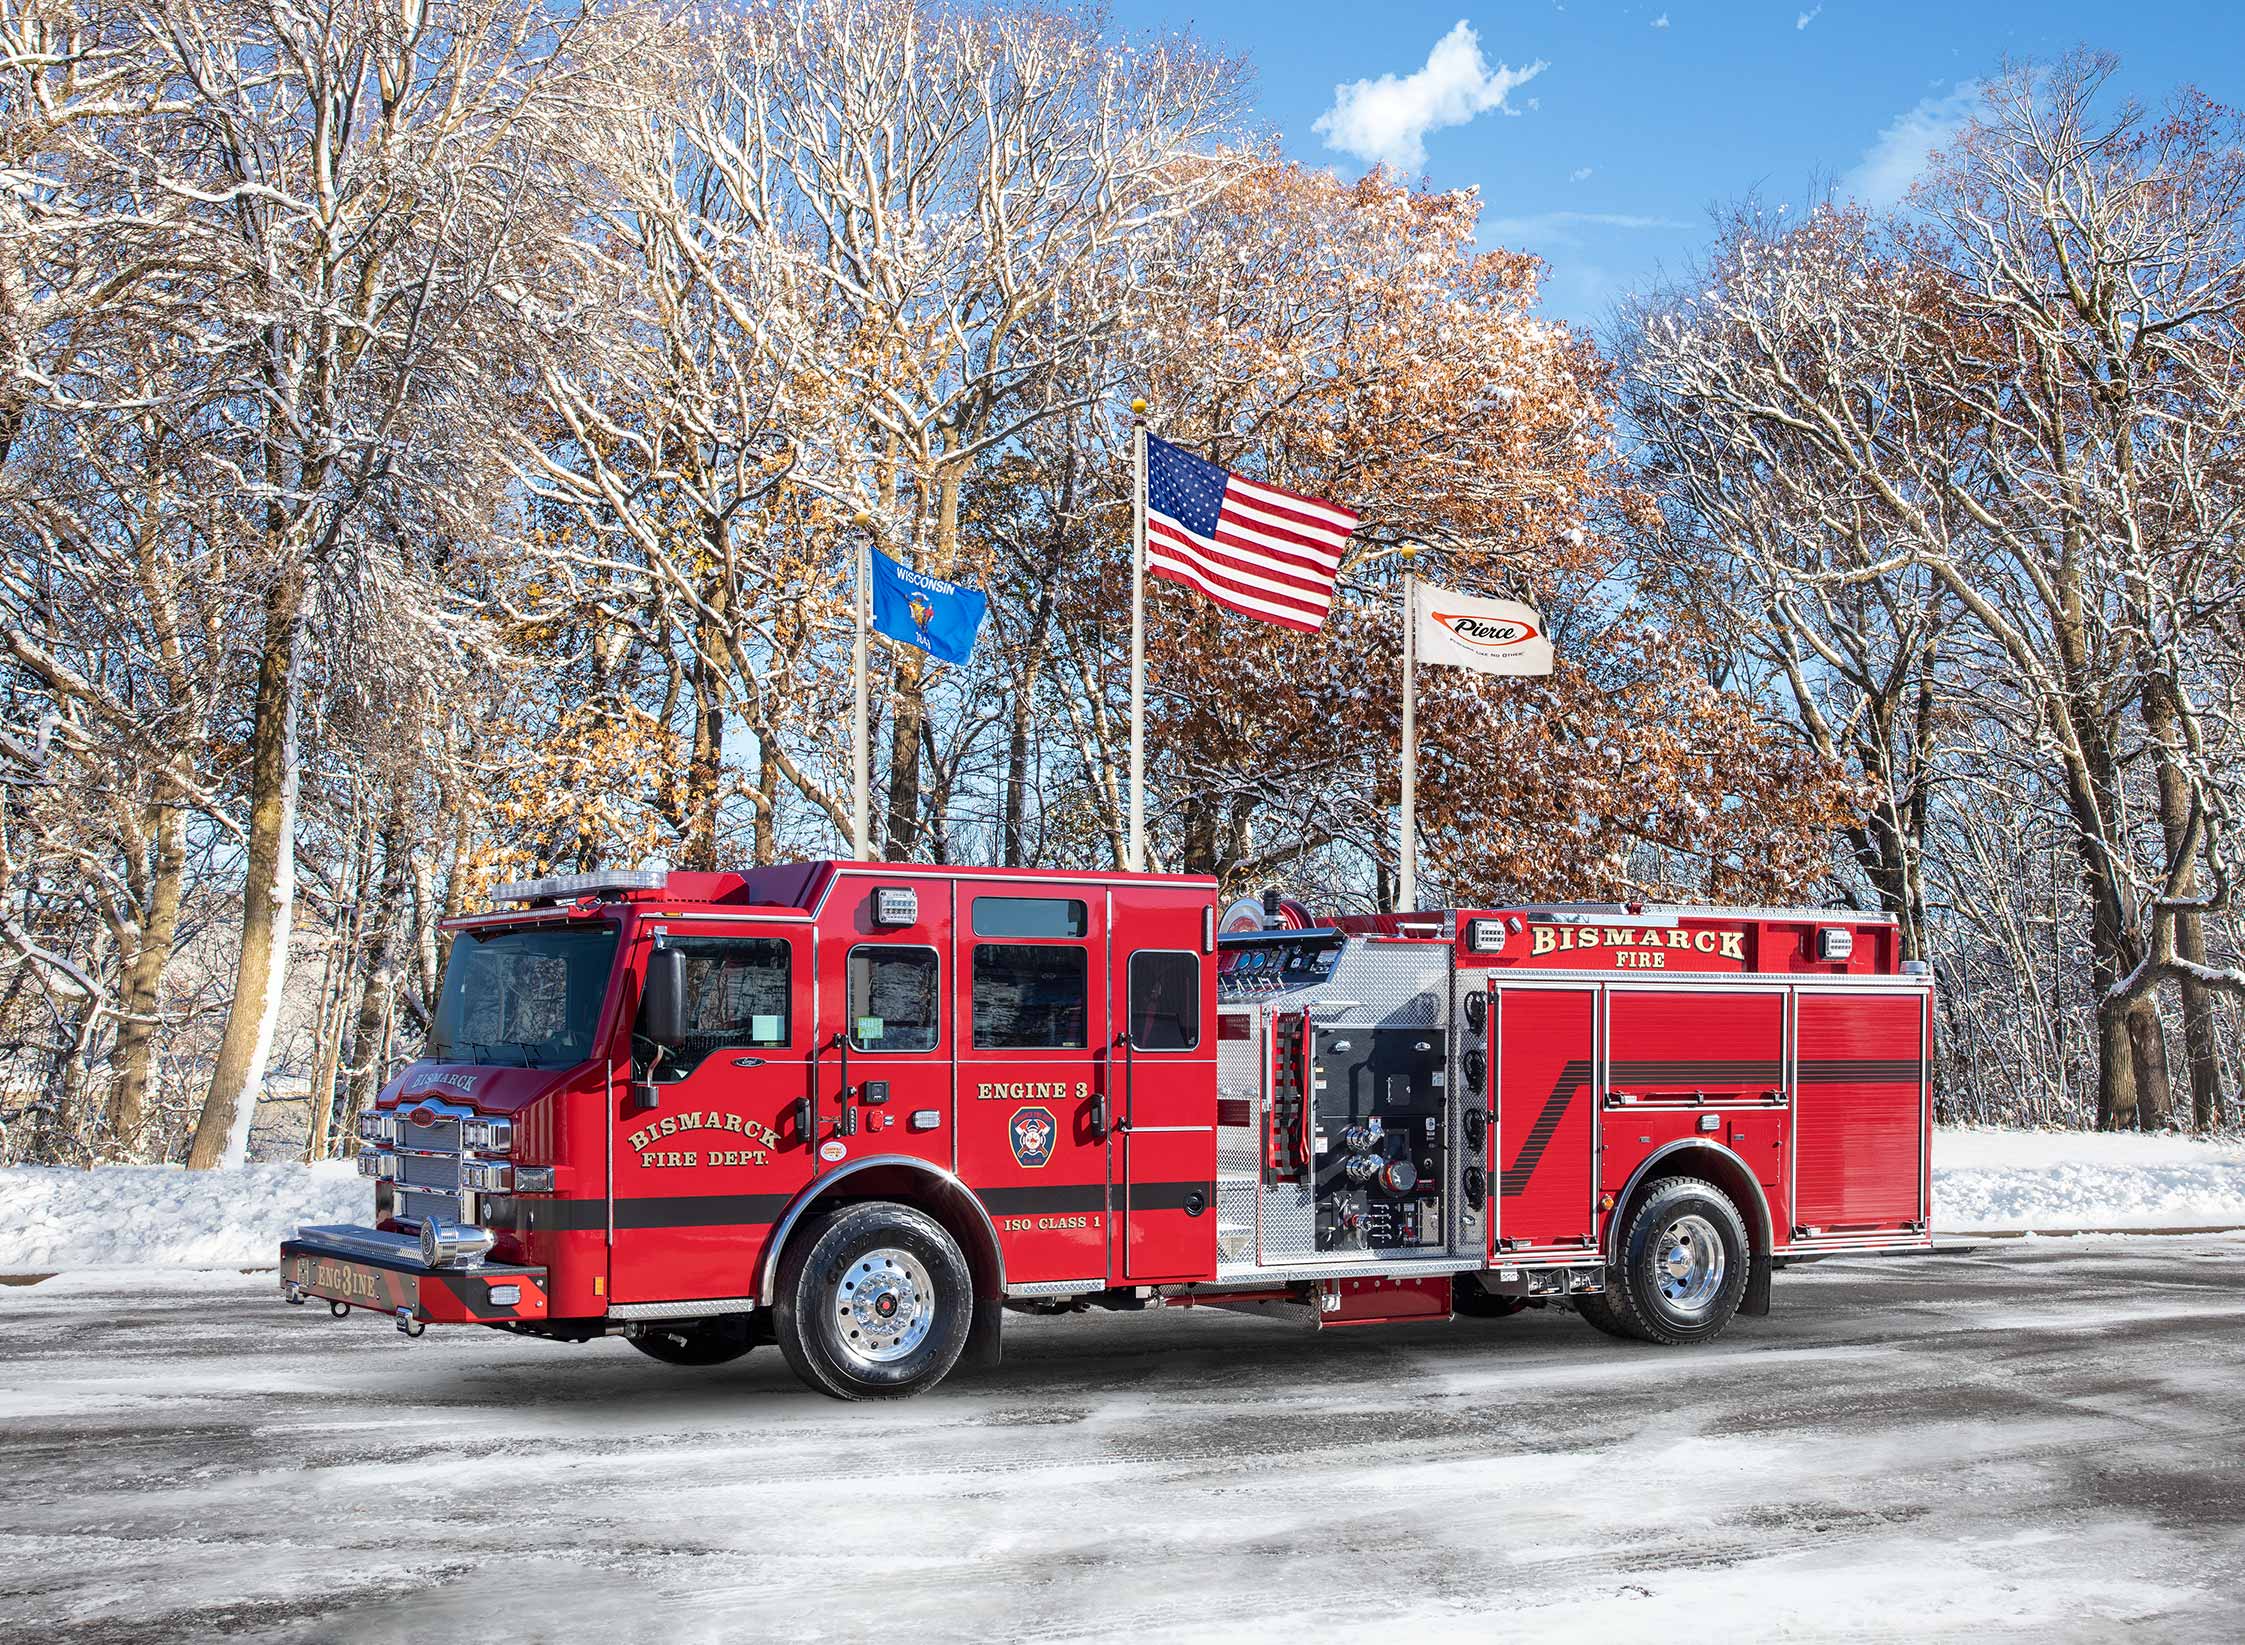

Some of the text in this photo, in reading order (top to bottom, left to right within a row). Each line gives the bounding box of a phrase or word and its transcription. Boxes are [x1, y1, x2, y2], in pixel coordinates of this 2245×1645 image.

[896, 567, 955, 595] WISCONSIN
[1454, 619, 1515, 639] Pierce
[1531, 927, 1744, 960] BISMARCK
[1616, 951, 1664, 968] FIRE
[411, 1073, 477, 1092] BISMARCK
[977, 1082, 1088, 1100] ENGINE 3
[627, 1112, 782, 1151] BISMARCK
[641, 1151, 769, 1167] FIRE DEPT.
[1004, 1216, 1100, 1231] ISO CLASS 1
[318, 1265, 375, 1297] ENG3INE
